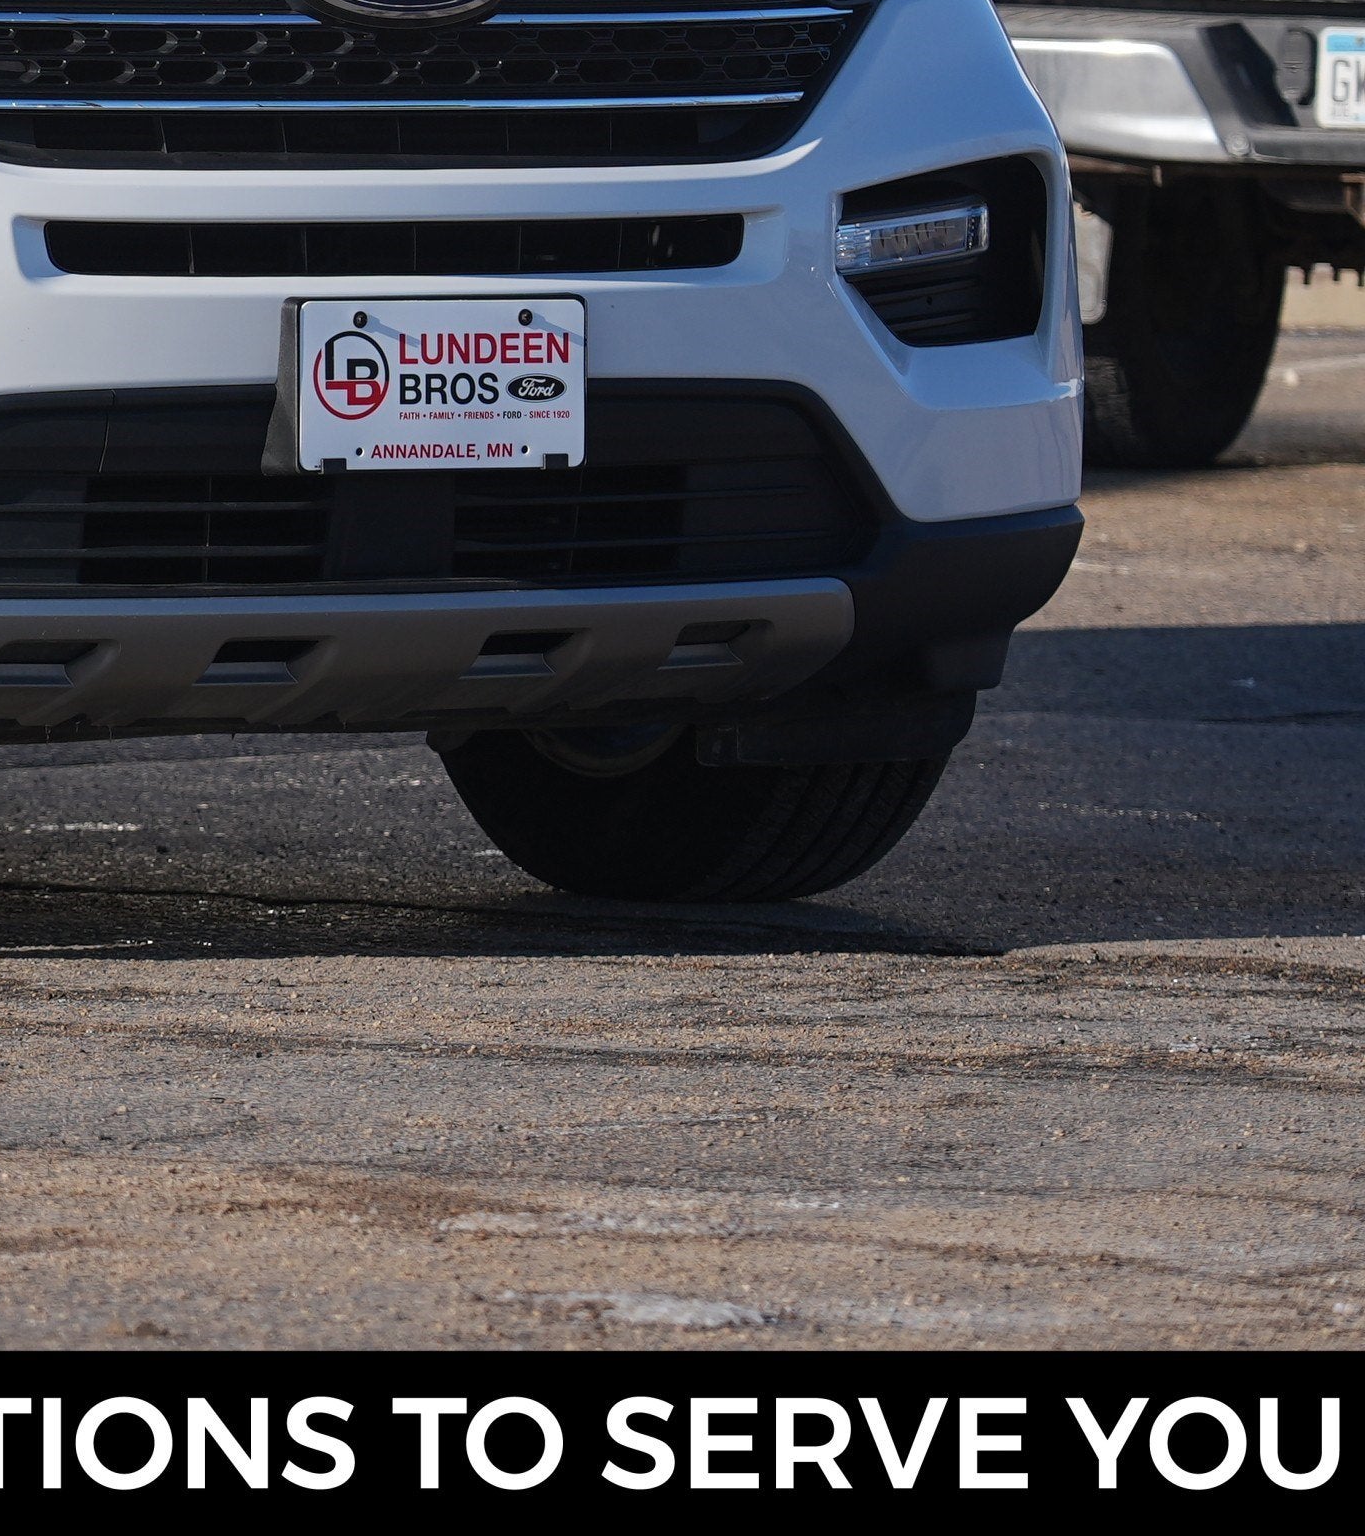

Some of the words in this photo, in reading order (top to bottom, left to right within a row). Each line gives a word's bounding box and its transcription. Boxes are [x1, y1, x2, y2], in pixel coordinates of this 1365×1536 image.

[399, 332, 569, 365] LUNDEEN
[399, 373, 499, 405] BROS
[518, 378, 556, 398] Ford
[399, 411, 420, 420] FAITH
[429, 411, 455, 420] FAMILY
[463, 411, 495, 419] FRIENDS
[502, 410, 522, 419] FORD
[529, 410, 550, 419] SINCE
[553, 410, 570, 419] 1920
[371, 443, 481, 461] ANNANDALE,
[487, 443, 513, 458] MN
